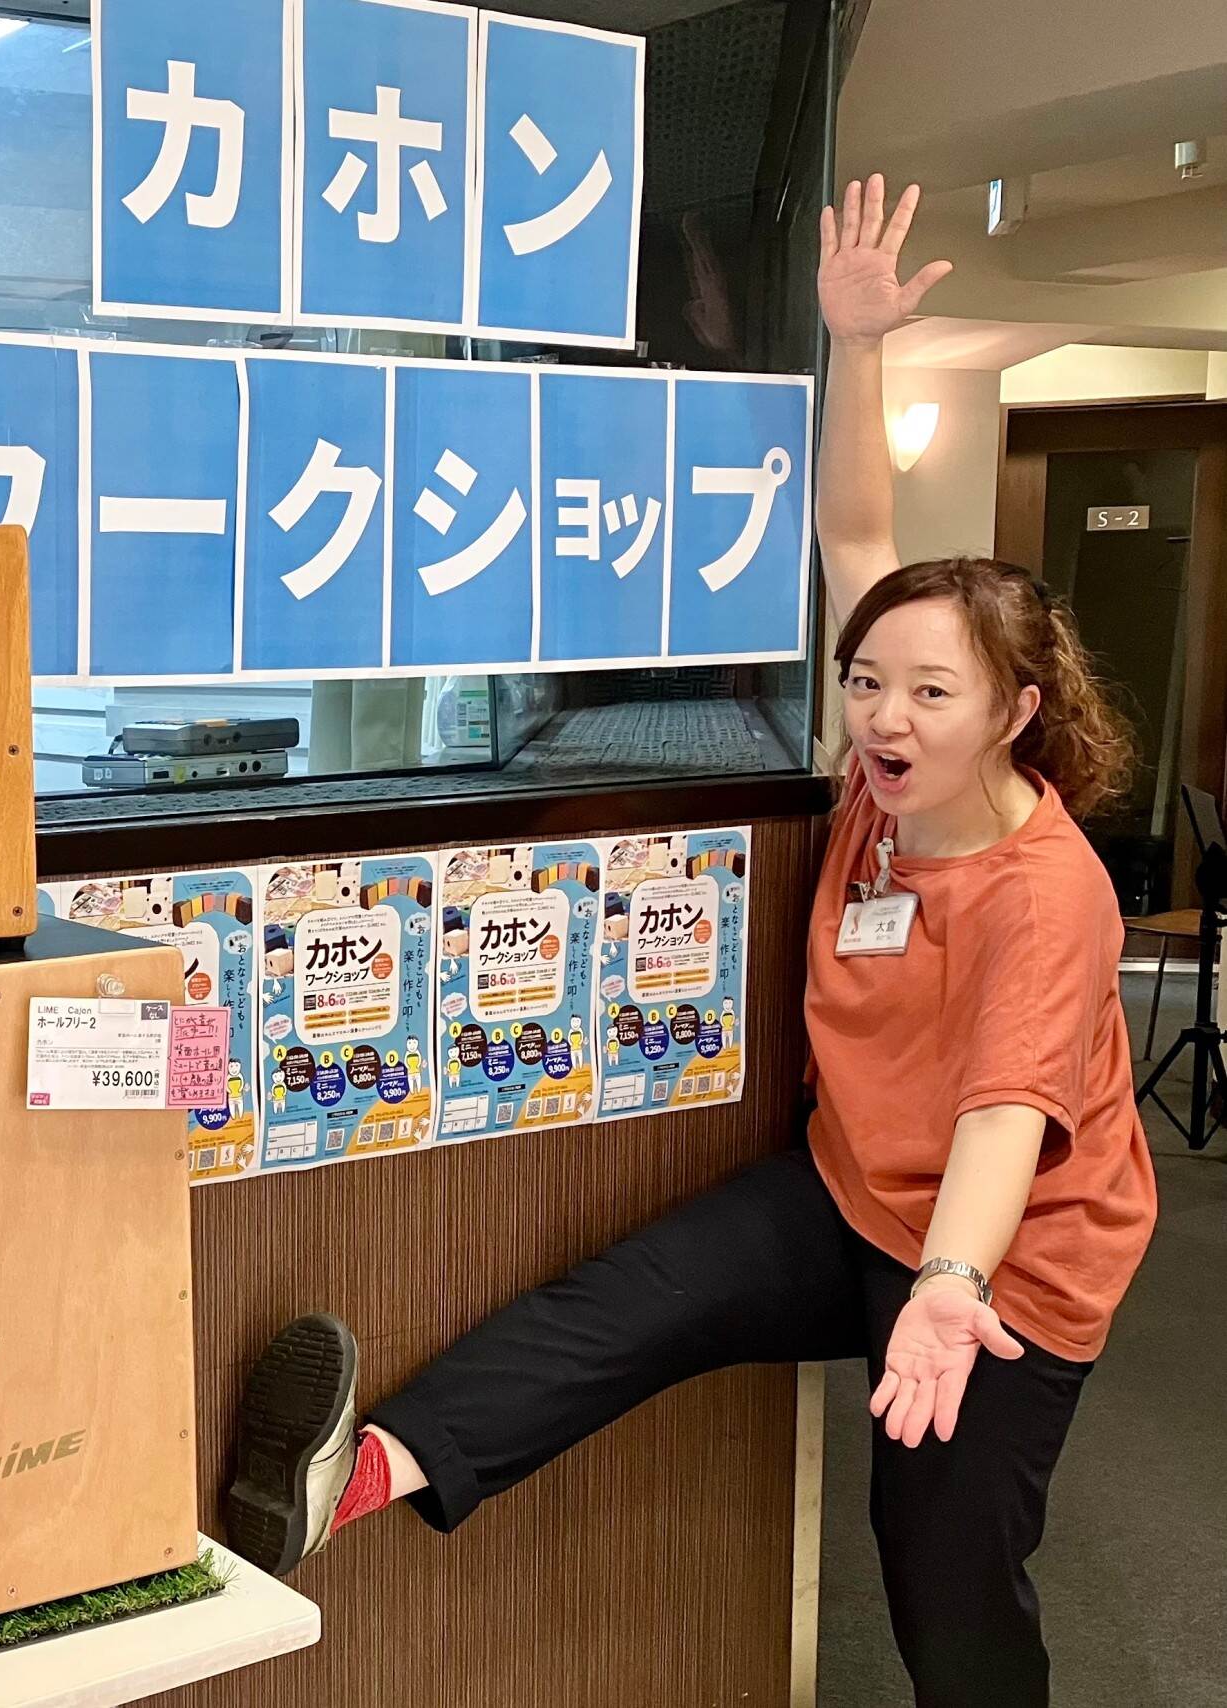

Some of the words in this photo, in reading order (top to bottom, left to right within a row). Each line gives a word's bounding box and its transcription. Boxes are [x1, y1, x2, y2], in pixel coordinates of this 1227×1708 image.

[120, 60, 613, 256] カホン
[638, 903, 704, 935] カホン
[479, 917, 551, 951] カホン
[637, 932, 693, 949] ワークショップ
[305, 935, 383, 971] カホン
[479, 947, 538, 966] ワークショップ
[305, 966, 371, 987] ワークショップ
[611, 1006, 617, 1015] A
[668, 1007, 674, 1015] C
[651, 1012, 657, 1021] B
[707, 1013, 713, 1021] D
[37, 1016, 96, 1029] ホールフリー2
[452, 1025, 458, 1034] A
[513, 1025, 519, 1034] C
[495, 1031, 501, 1040] B
[554, 1031, 560, 1040] D
[277, 1048, 283, 1058] A
[344, 1048, 350, 1057] C
[324, 1055, 330, 1064] B
[389, 1054, 395, 1063] D
[92, 1070, 154, 1087] ¥39,600
